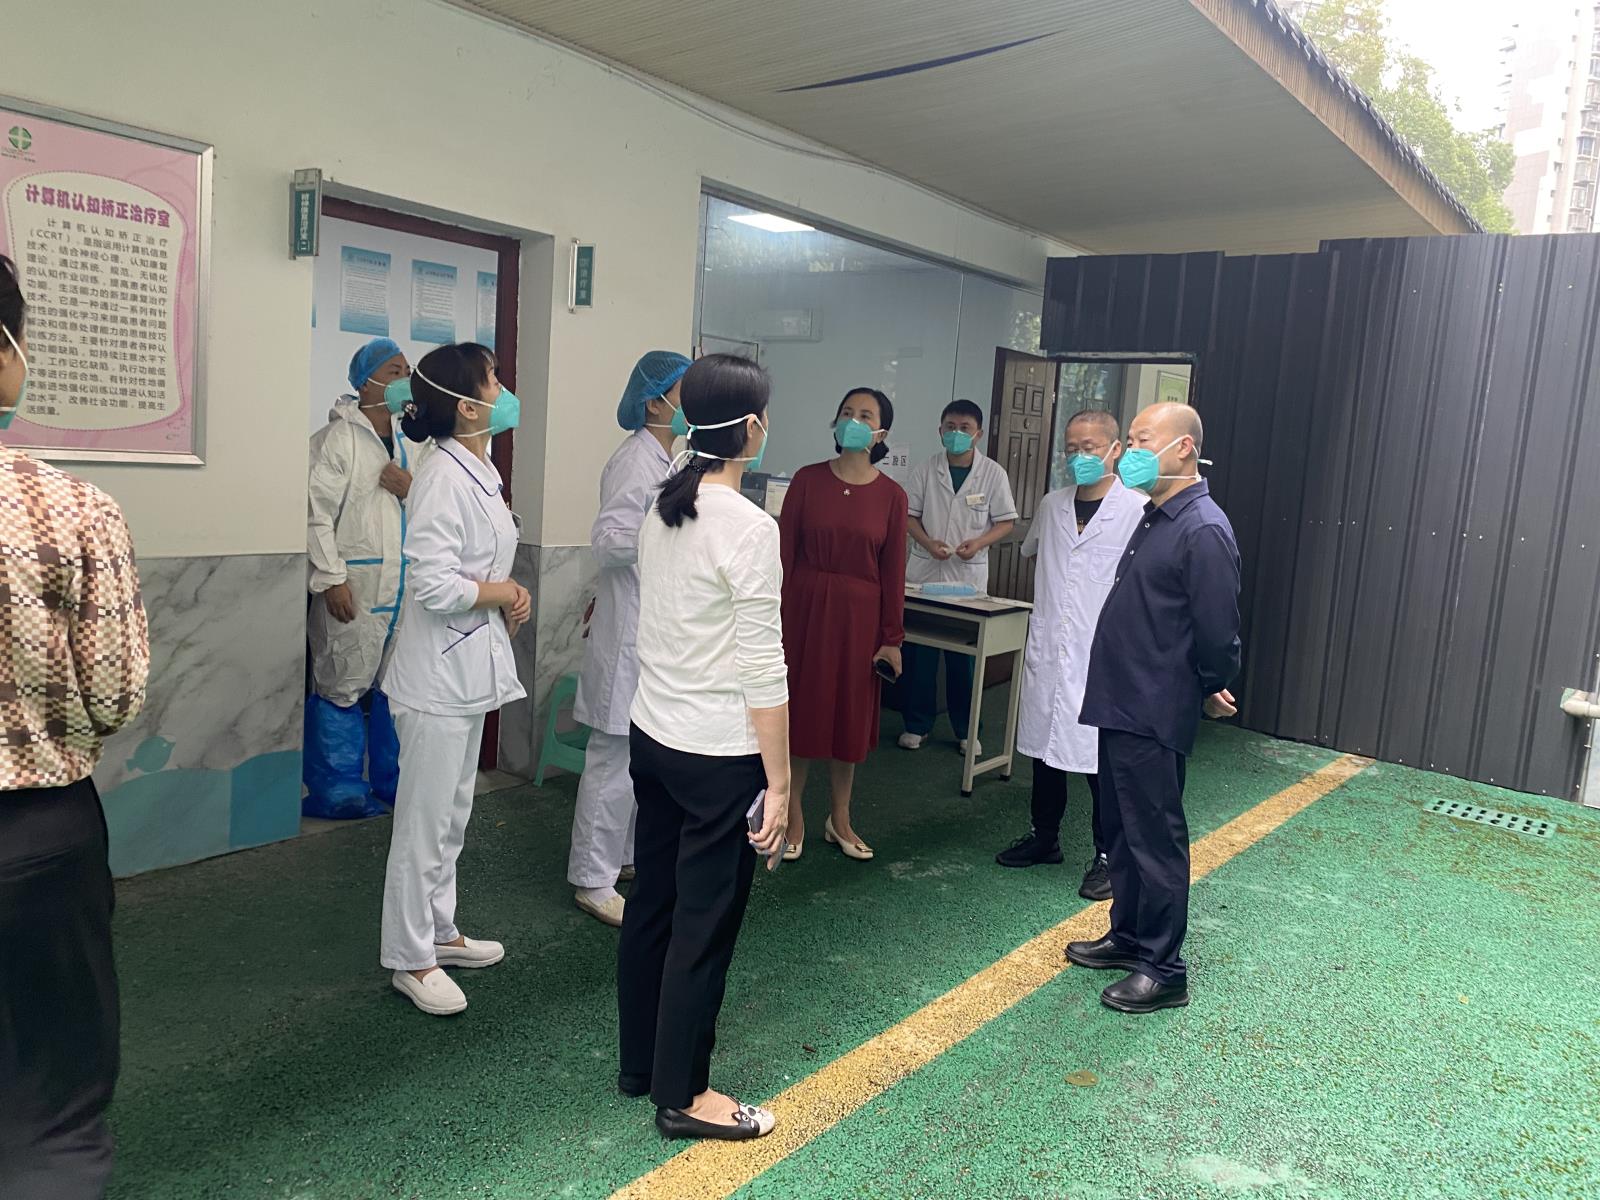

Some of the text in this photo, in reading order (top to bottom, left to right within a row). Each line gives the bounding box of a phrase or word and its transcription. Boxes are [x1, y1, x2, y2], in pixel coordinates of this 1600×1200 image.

[25, 183, 170, 228] 计算机认知矫正治疗室
